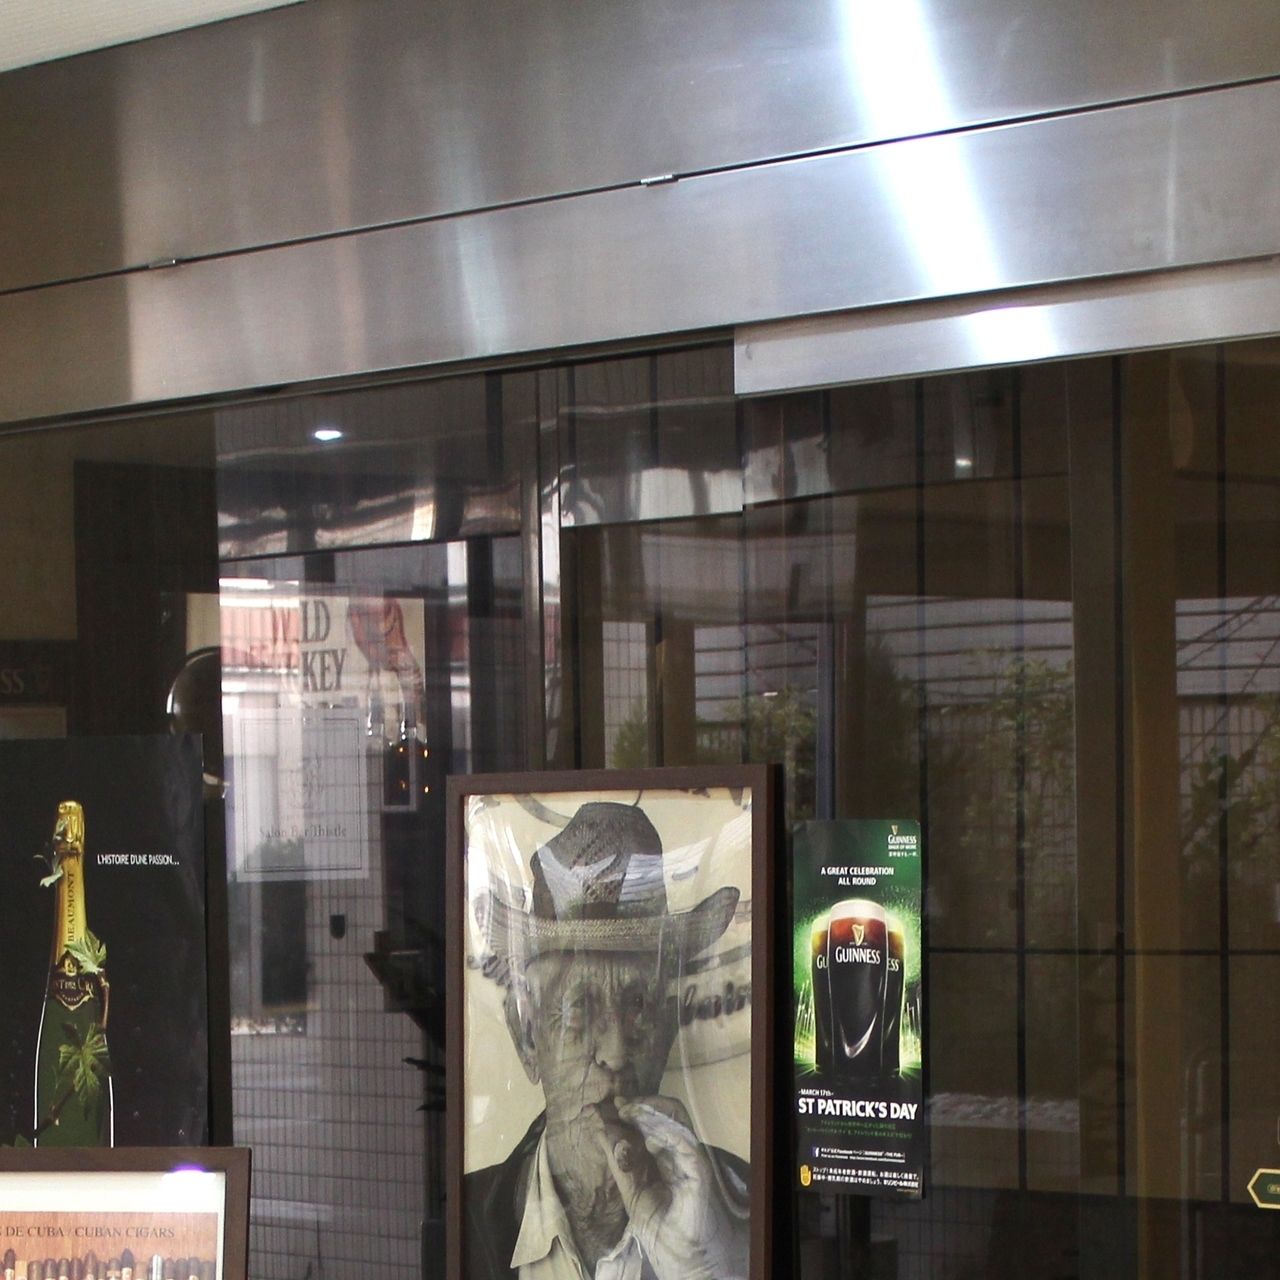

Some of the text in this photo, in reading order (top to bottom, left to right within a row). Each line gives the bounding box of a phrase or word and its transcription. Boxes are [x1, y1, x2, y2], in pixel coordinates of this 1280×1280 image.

[887, 834, 917, 845] GUINNESS
[821, 867, 895, 876] A GREAT CELEBRATION
[838, 877, 877, 886] ALL ROUND
[67, 872, 75, 942] BEAUMONT
[835, 945, 881, 965] GUINNESS
[798, 1098, 918, 1120] ST PATRICK'S DAY
[5, 1226, 24, 1237] DE
[27, 1226, 64, 1238] CUBA
[74, 1226, 121, 1238] CUBAN
[125, 1227, 175, 1238] CIGARS
